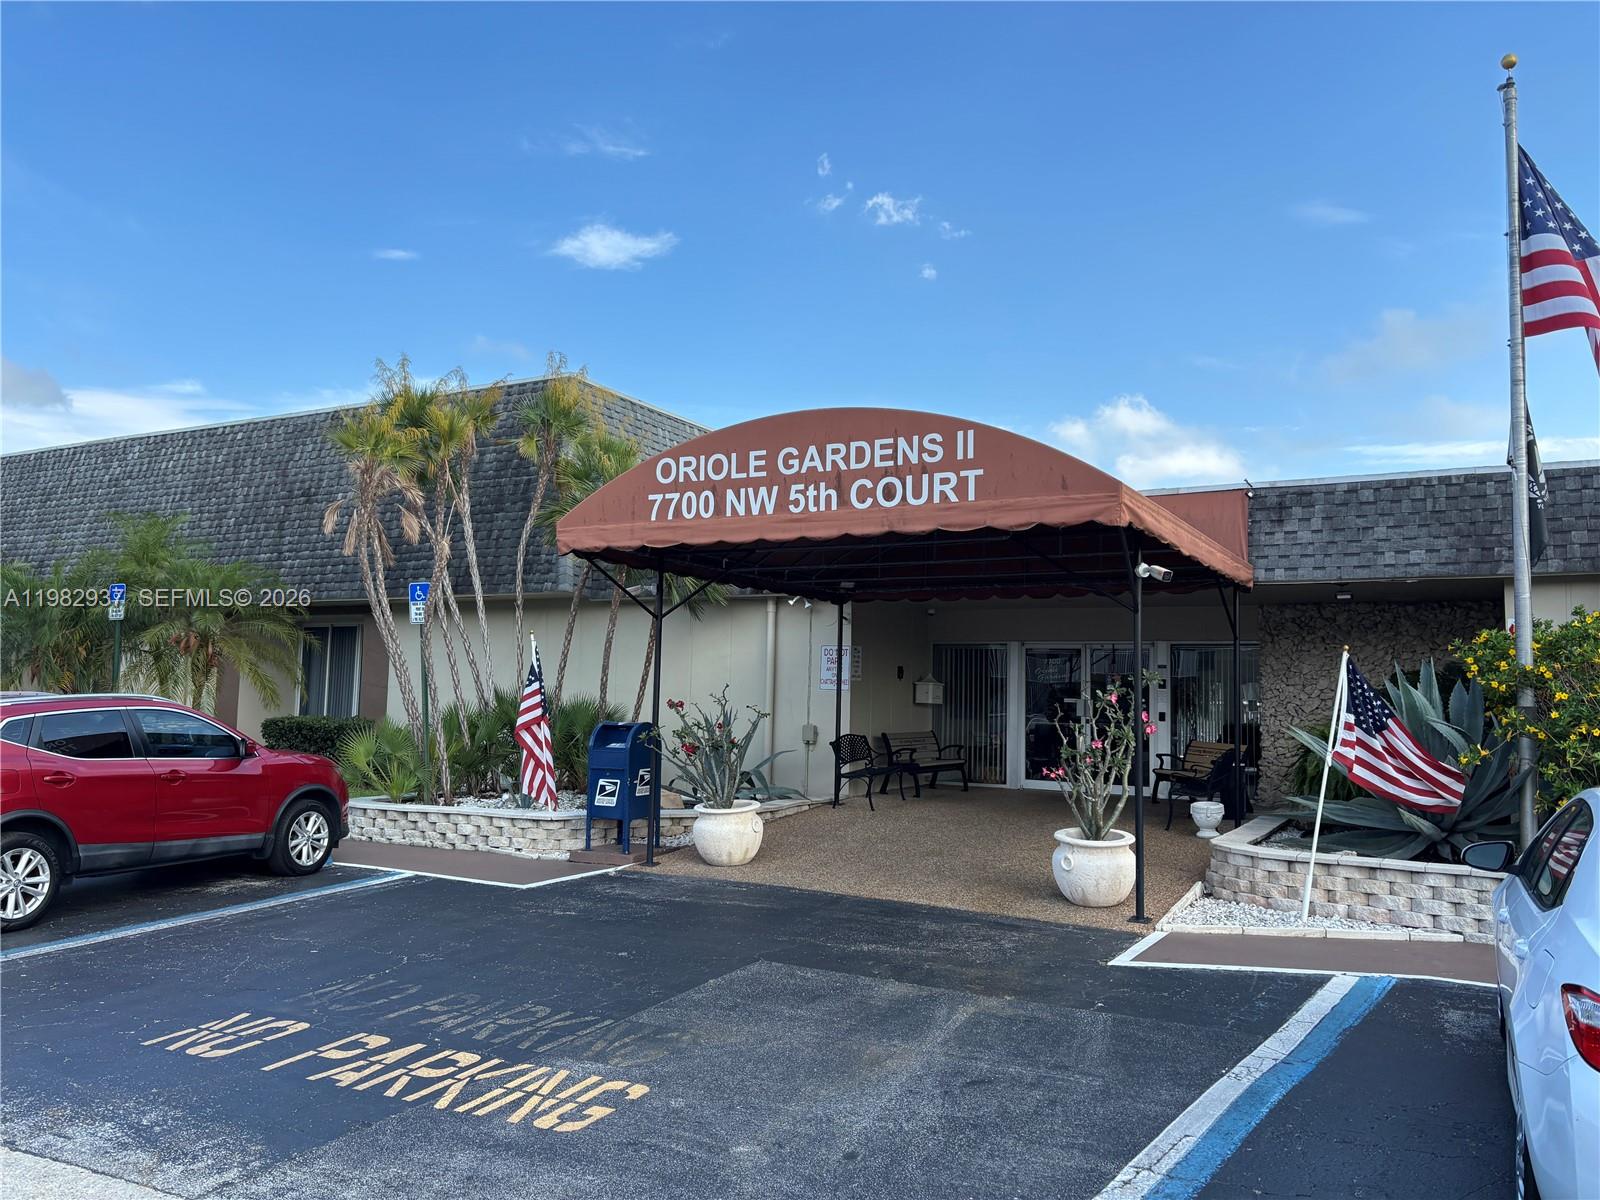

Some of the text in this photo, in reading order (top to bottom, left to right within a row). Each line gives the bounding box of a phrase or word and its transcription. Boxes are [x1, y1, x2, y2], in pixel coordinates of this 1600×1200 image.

[655, 429, 975, 485] ORIOLE GARDENS II
[647, 468, 985, 522] 7700 NW 5th COURT
[140, 1012, 650, 1133] NO PARKING
